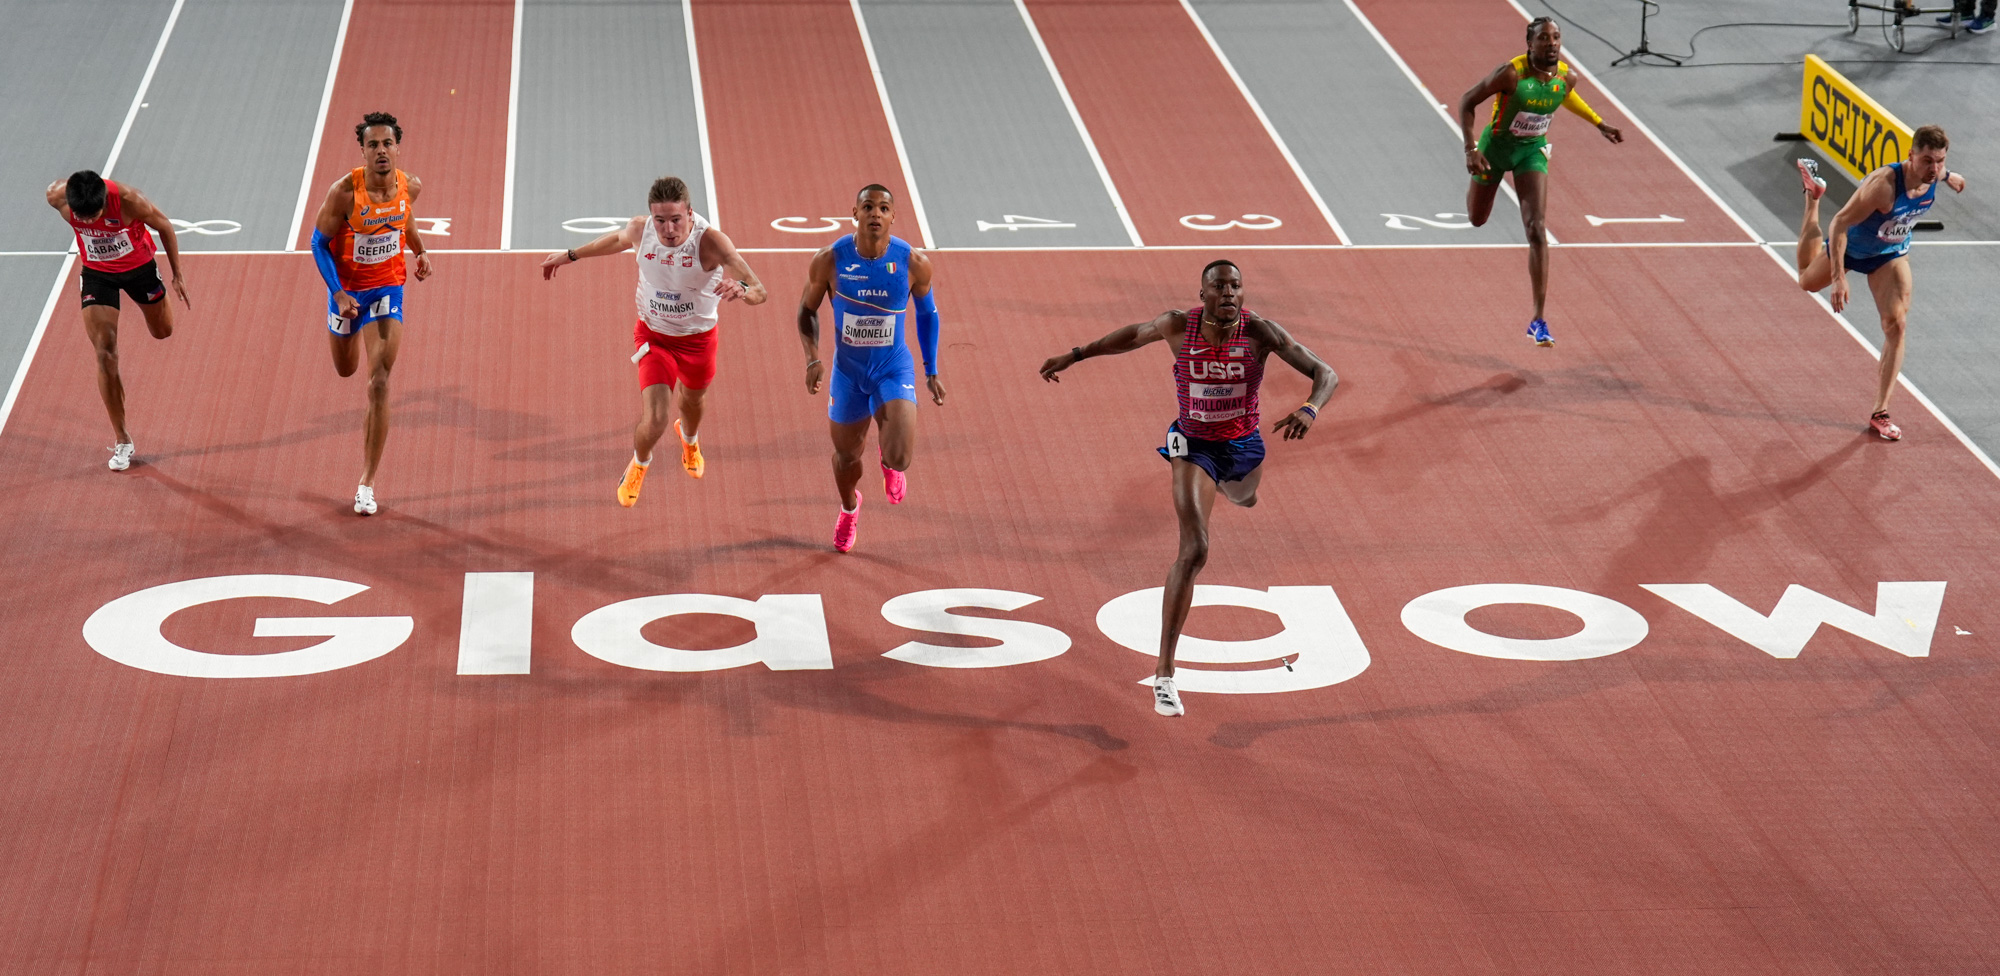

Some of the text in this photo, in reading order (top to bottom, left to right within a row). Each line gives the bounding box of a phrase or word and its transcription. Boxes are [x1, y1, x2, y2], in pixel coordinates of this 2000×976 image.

[1526, 99, 1553, 107] MALI
[1513, 120, 1548, 131] DIAWARA
[1811, 75, 1900, 175] SEIKO
[364, 213, 404, 226] Nederland
[770, 216, 857, 233] 5
[976, 214, 1076, 231] 4
[1179, 213, 1282, 231] 3
[1380, 213, 1473, 230] 2
[87, 240, 128, 255] CABANG
[358, 241, 397, 256] GEERDS
[857, 289, 888, 297] ITALIA
[649, 299, 694, 313] SZYMAŃSKI
[336, 317, 343, 330] 7
[845, 325, 892, 339] SIMONELLI
[1189, 360, 1245, 380] USA
[1192, 399, 1244, 411] HOLLOWAY
[1204, 411, 1236, 420] GLASGOW
[1172, 436, 1179, 453] 4
[82, 571, 1947, 694] Glasgow
